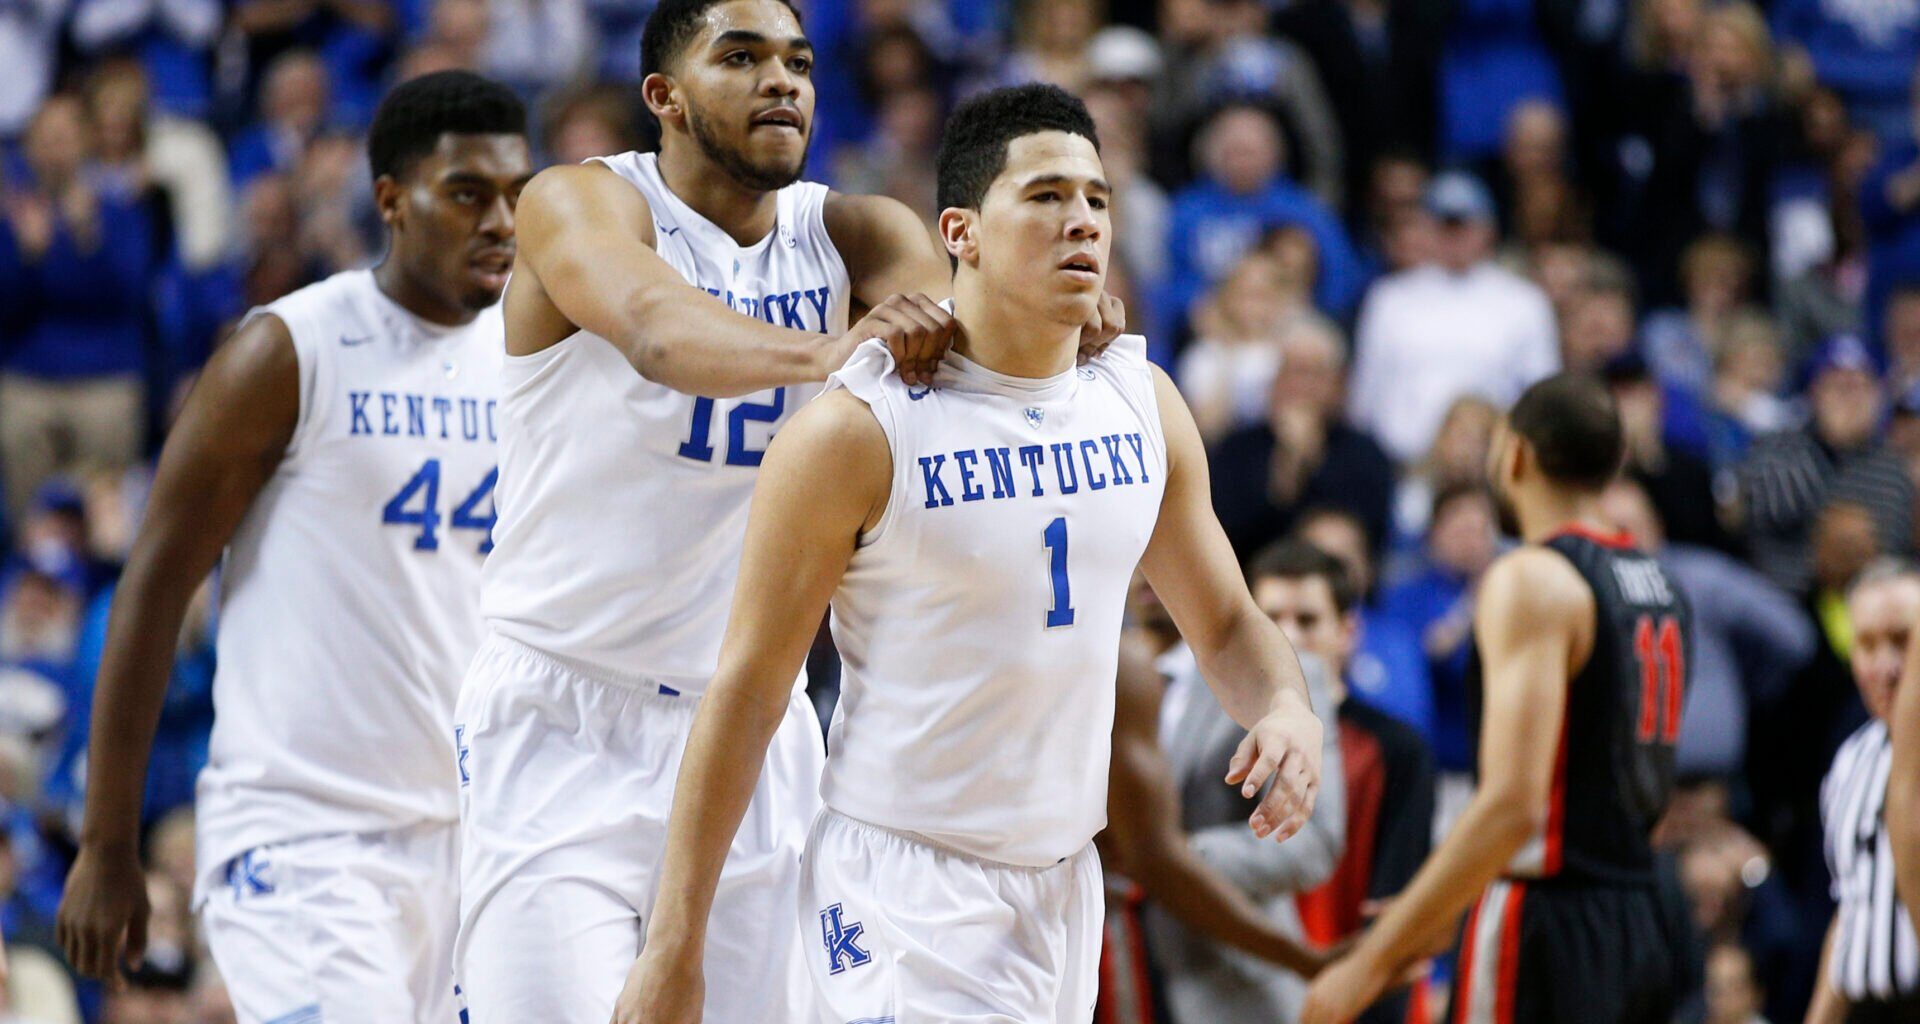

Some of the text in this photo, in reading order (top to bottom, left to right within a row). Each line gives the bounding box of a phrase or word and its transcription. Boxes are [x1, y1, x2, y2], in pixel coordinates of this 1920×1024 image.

[349, 391, 497, 442] KENTUC
[678, 385, 785, 467] 12
[382, 458, 498, 554] 44
[918, 433, 1149, 509] KENTUCKY
[1041, 516, 1076, 629] 1
[1634, 614, 1684, 744] 11
[819, 902, 872, 975] UK
